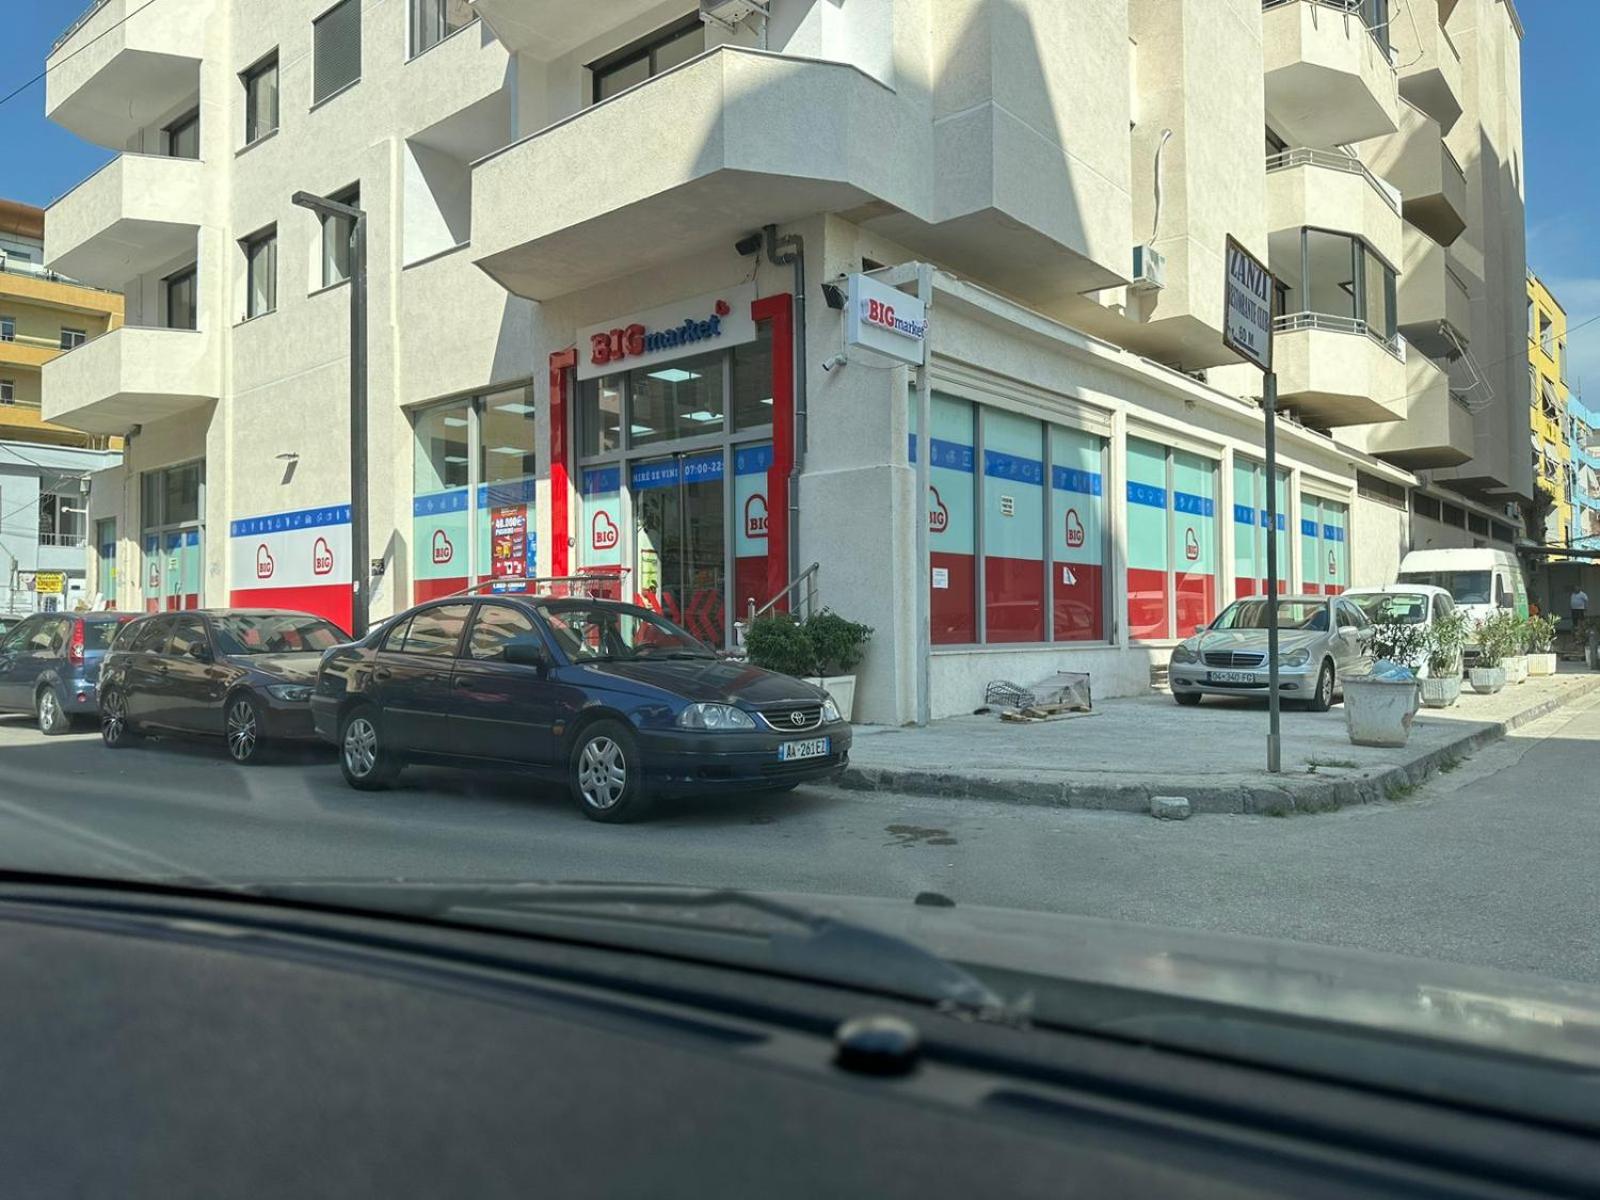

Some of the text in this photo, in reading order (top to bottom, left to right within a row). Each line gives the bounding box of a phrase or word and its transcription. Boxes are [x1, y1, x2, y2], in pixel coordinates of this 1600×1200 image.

[1230, 249, 1268, 302] ZANZI
[596, 531, 615, 543] BIG
[1068, 530, 1082, 541] BIG
[435, 547, 450, 558] BIG
[259, 562, 271, 573] BIG
[316, 556, 331, 569] BIG
